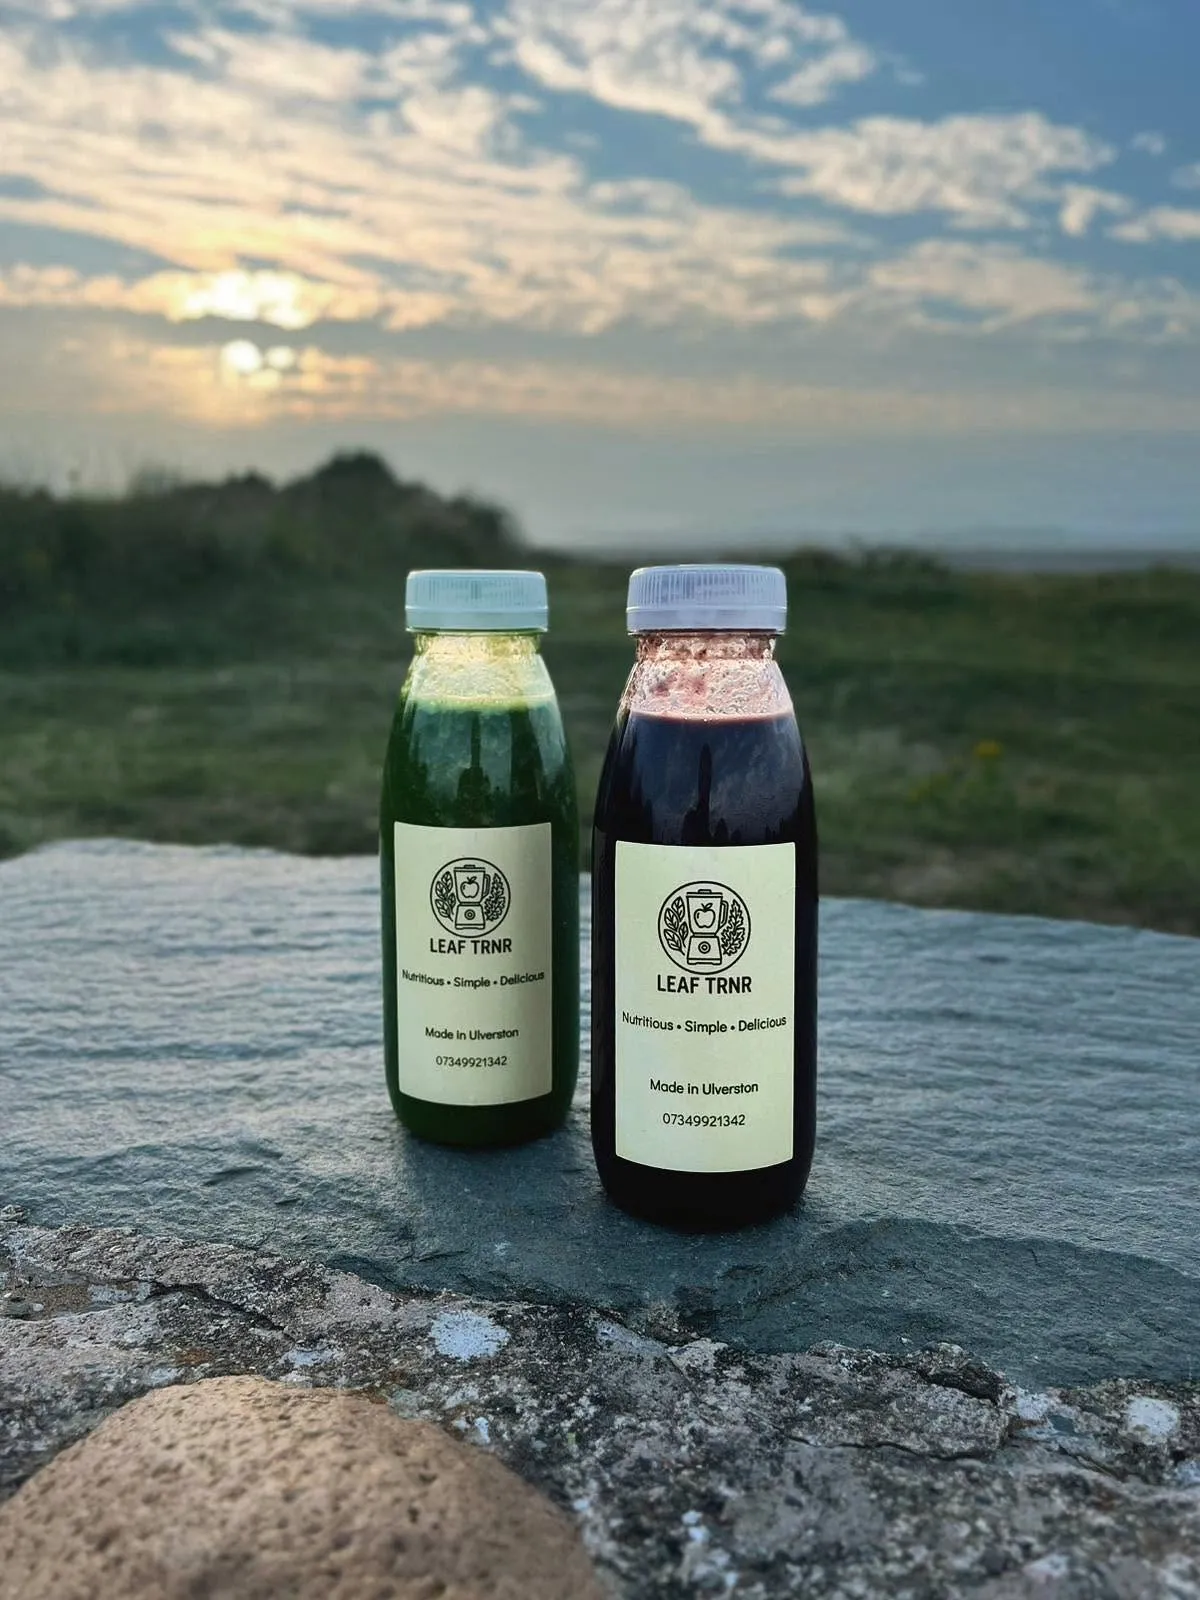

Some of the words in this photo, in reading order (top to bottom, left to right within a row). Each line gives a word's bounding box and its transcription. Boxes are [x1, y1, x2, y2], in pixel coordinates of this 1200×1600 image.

[430, 938, 466, 954] LEAF
[470, 938, 512, 955] TRNR
[402, 969, 444, 986] Nutritious
[453, 977, 490, 989] Simple
[500, 971, 545, 986] Delicious
[657, 974, 700, 993] LEAF
[705, 976, 752, 994] TRNR
[622, 1011, 674, 1031] Nutritious
[684, 1020, 728, 1035] Simple
[738, 1016, 787, 1032] Delicious
[425, 1027, 454, 1040] Made
[456, 1030, 467, 1040] in
[469, 1028, 519, 1041] Ulverston
[436, 1056, 507, 1067] 07349921342
[650, 1078, 684, 1095] Made
[687, 1083, 699, 1095] in
[702, 1083, 759, 1096] Ulverston
[663, 1113, 746, 1127] 07349921342
